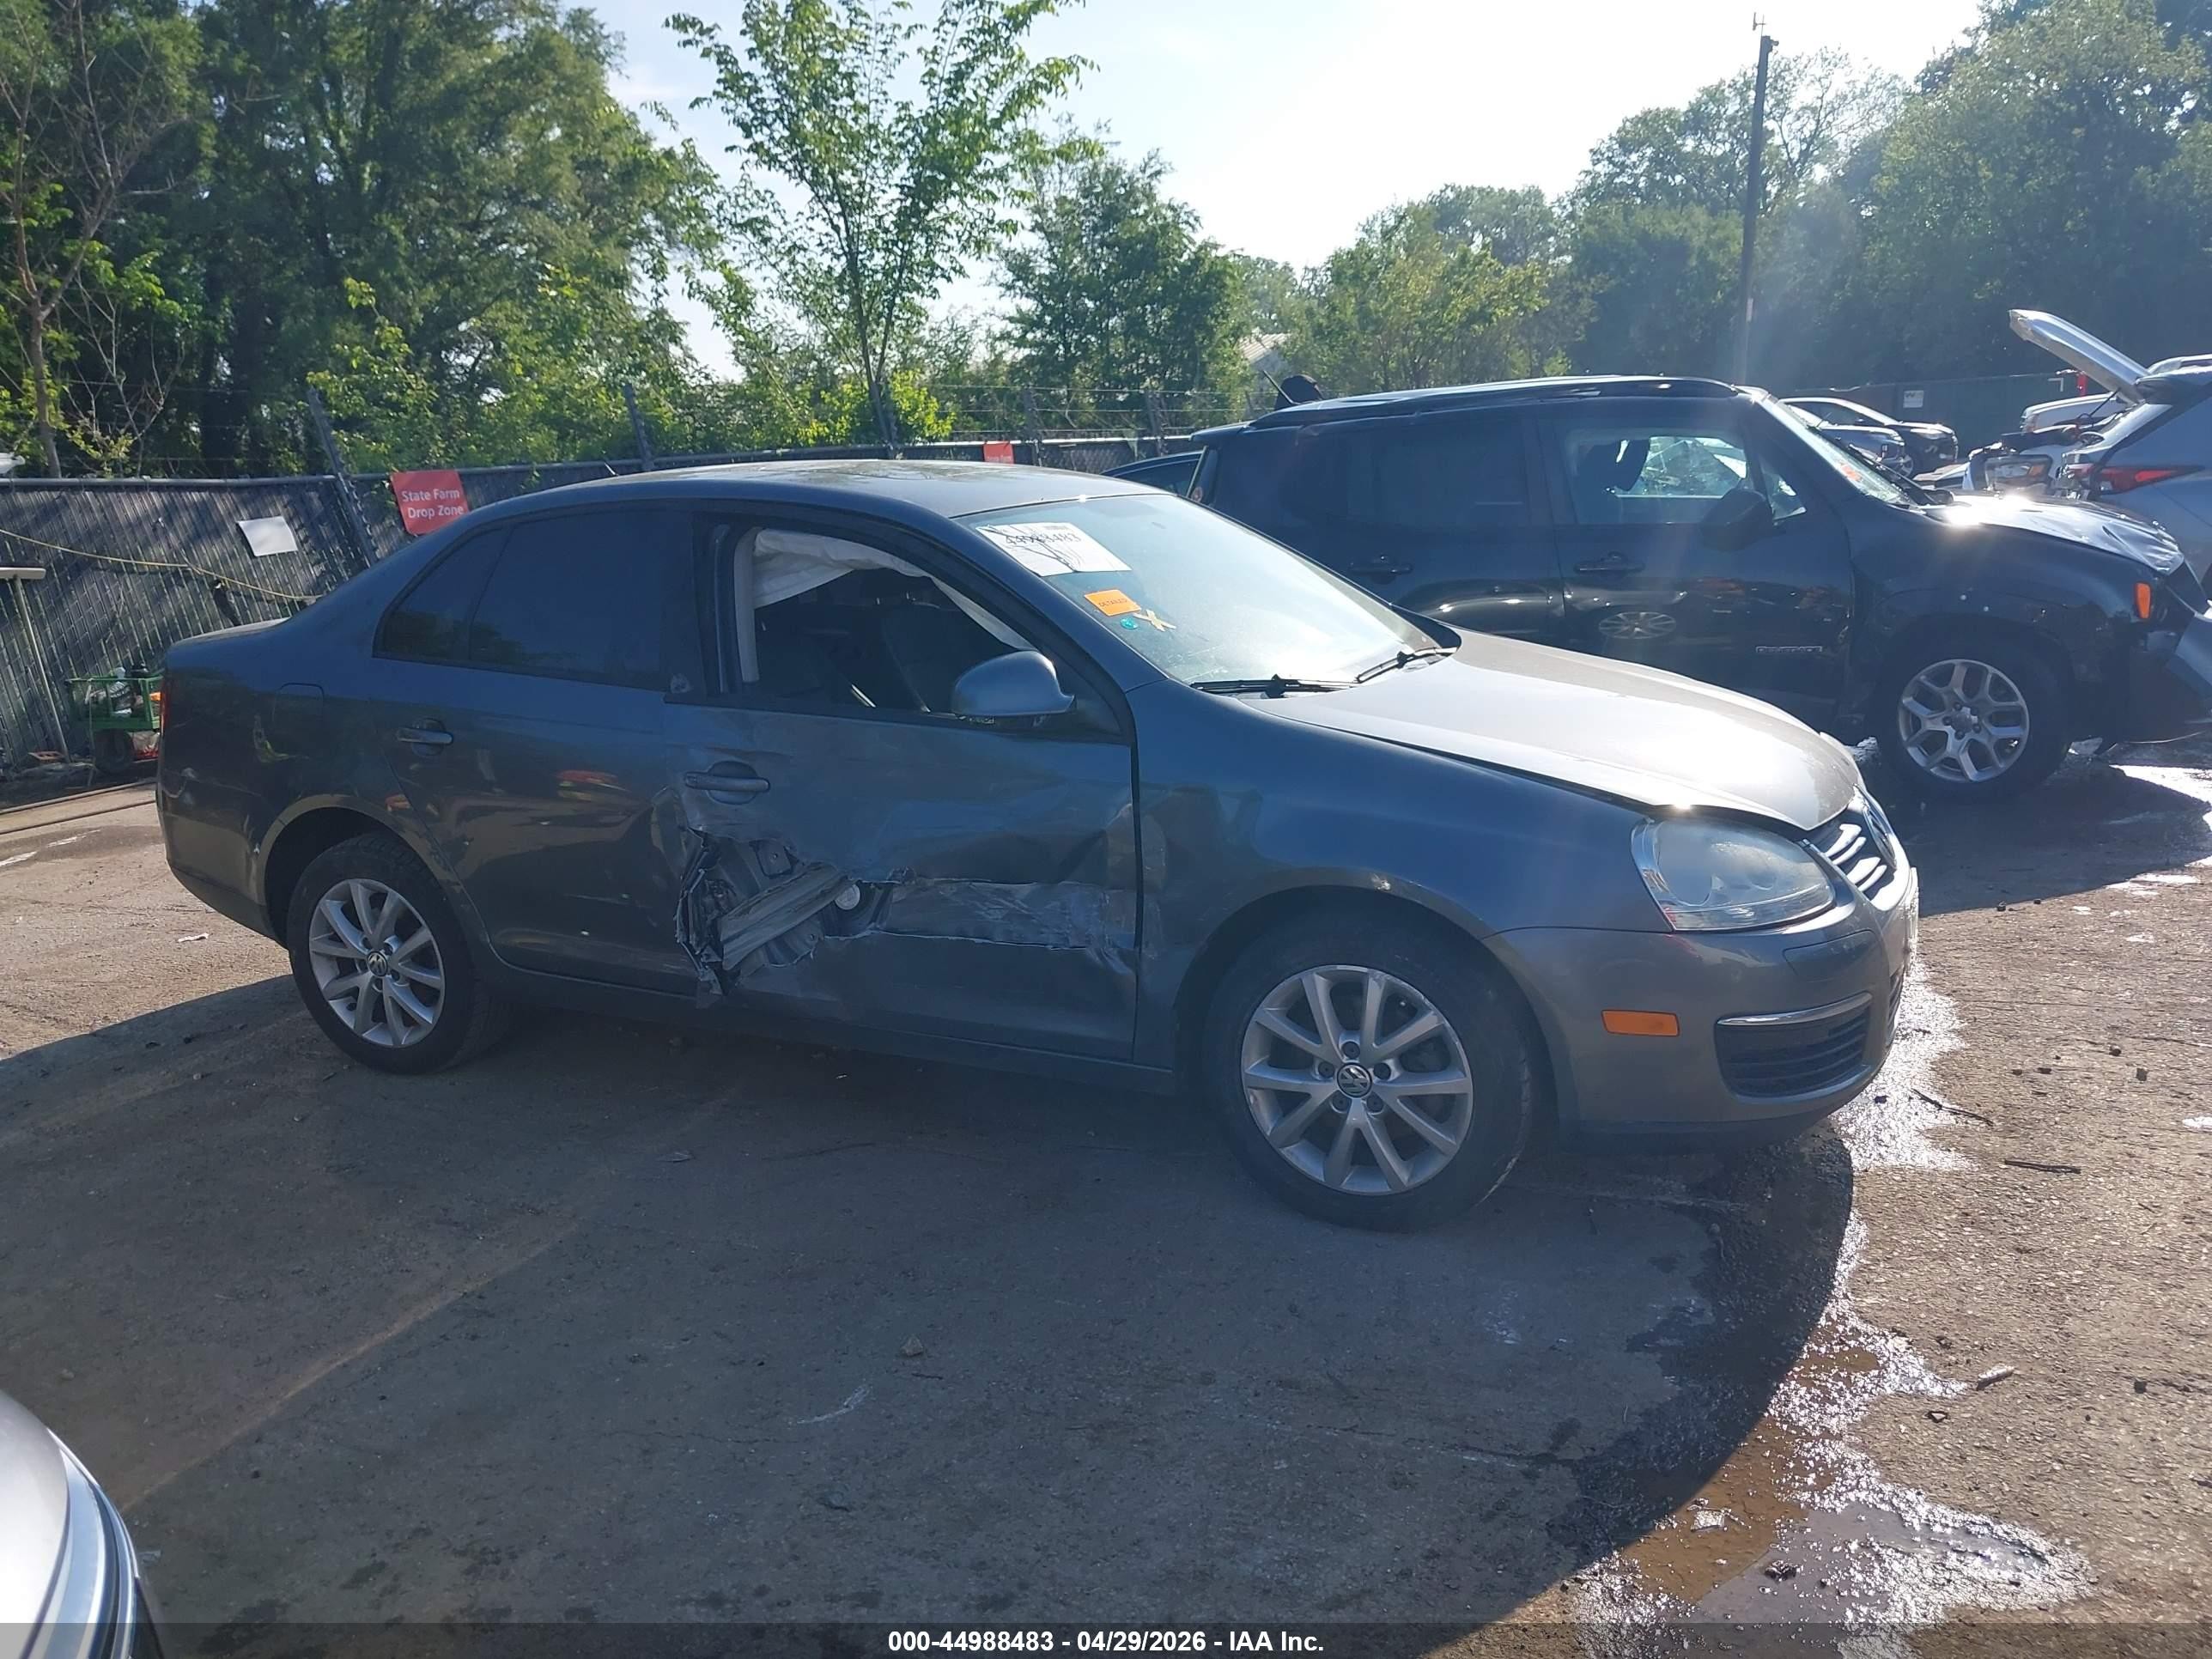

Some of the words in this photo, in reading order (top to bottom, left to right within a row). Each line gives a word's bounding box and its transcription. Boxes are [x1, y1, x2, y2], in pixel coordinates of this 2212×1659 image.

[402, 489, 431, 502] State
[433, 488, 460, 500] Farm
[408, 507, 435, 520] Drop
[438, 505, 464, 516] Zone
